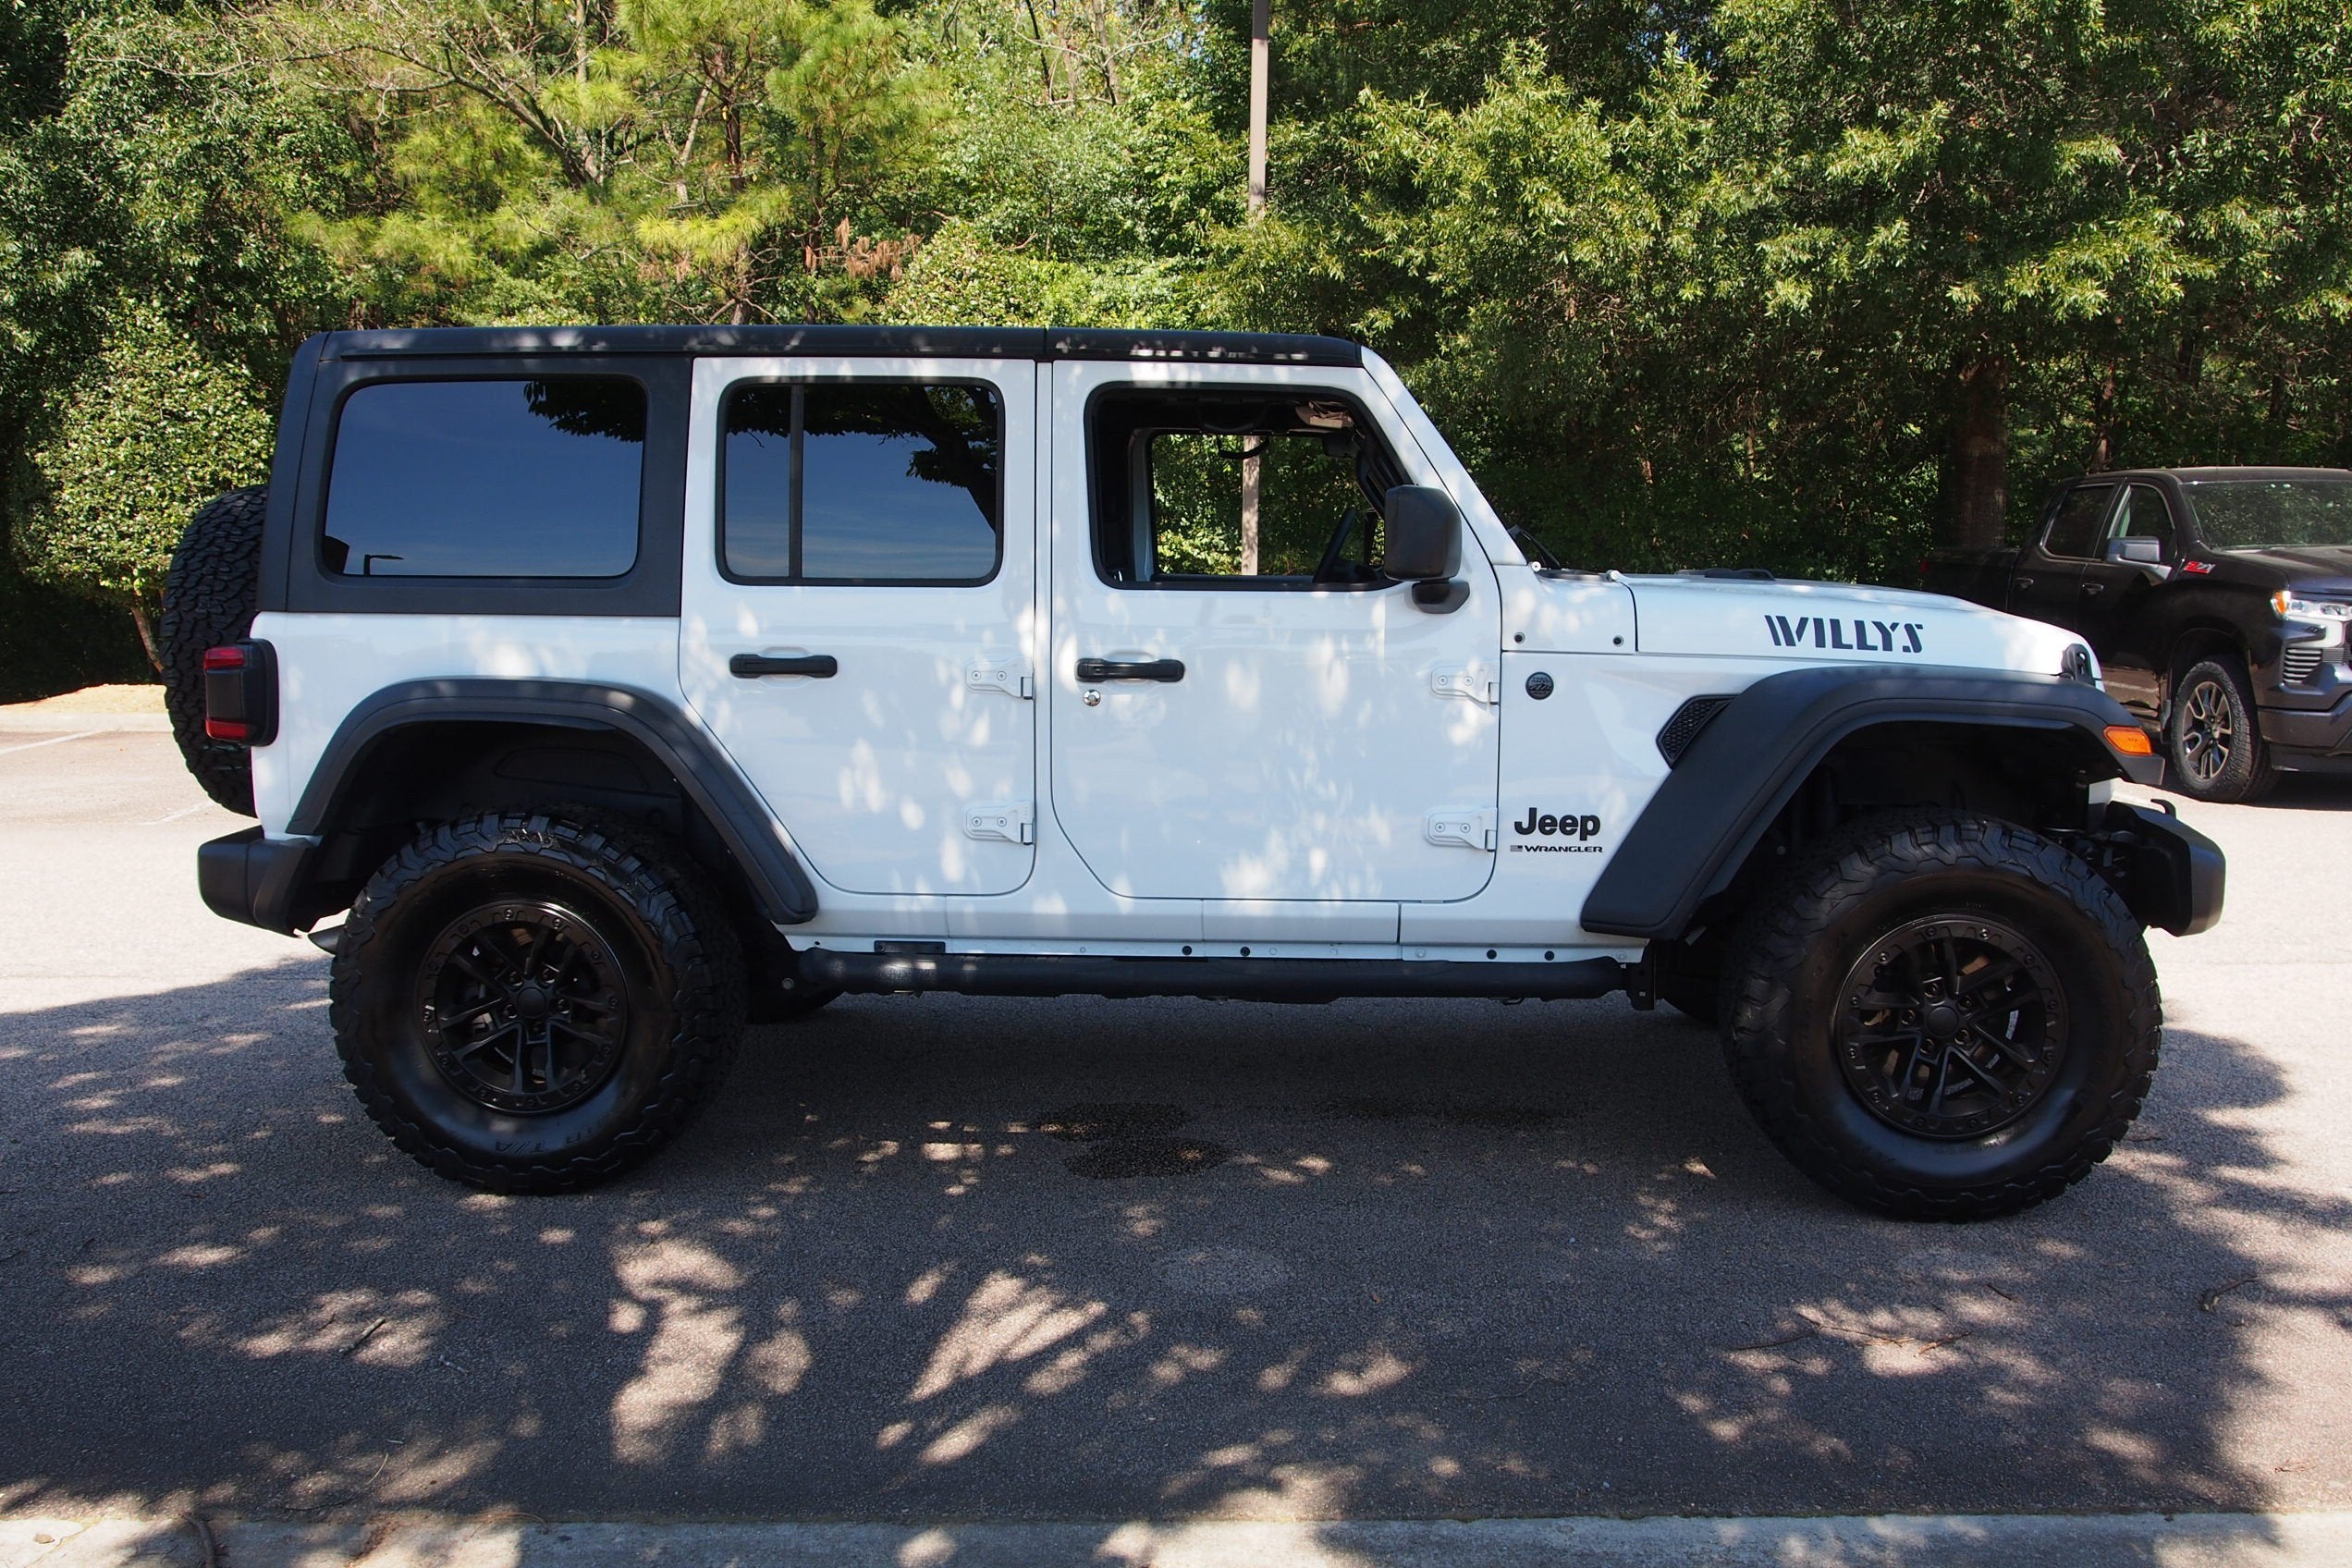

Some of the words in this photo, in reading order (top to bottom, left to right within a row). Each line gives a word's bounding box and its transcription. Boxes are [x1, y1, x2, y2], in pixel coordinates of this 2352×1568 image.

[1764, 614, 1924, 654] WILLYS
[1513, 807, 1601, 841] Jeep
[1524, 844, 1603, 853] WRANGLER
